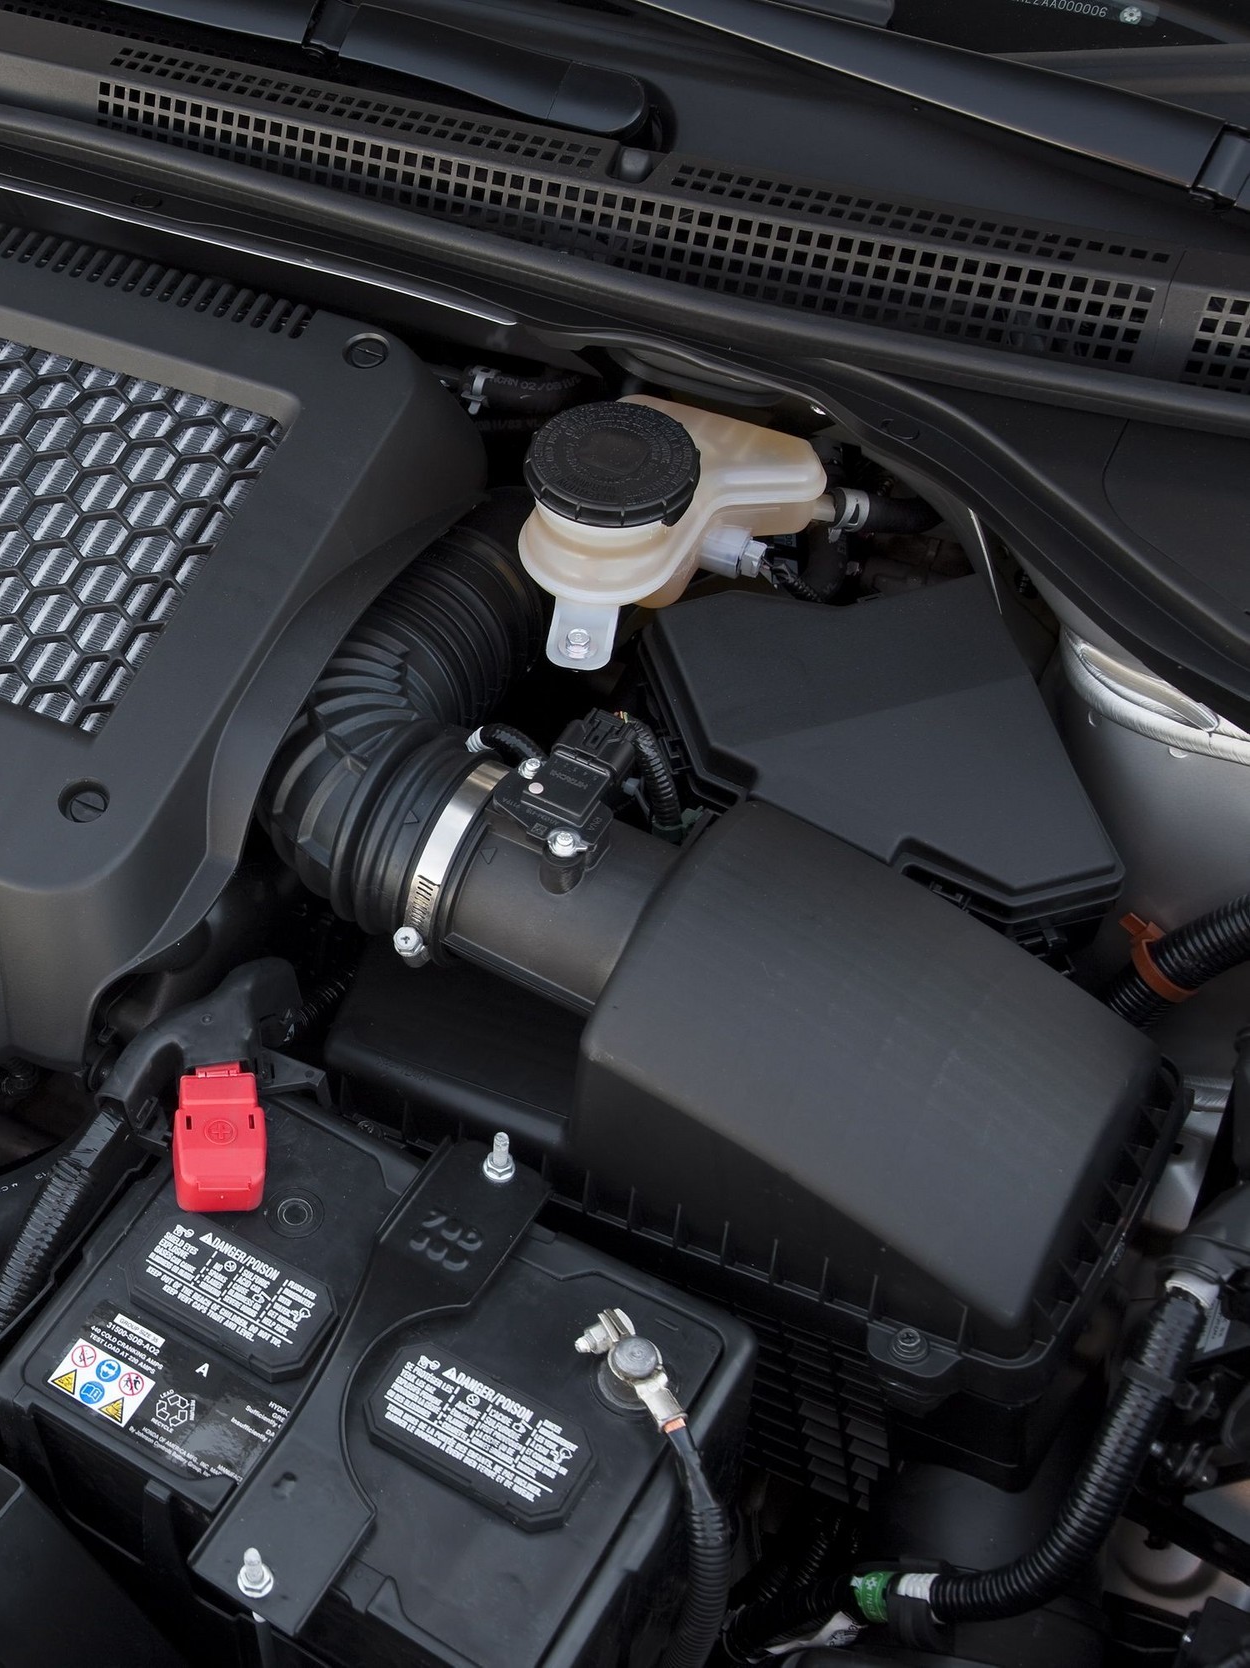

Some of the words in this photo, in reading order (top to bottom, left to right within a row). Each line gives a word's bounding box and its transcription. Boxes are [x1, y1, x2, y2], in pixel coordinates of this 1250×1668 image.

[550, 769, 589, 790] HITACHI
[159, 1239, 190, 1260] EXPLOSIVE
[164, 1232, 185, 1247] SHIELD
[183, 1243, 199, 1255] EYES
[211, 1237, 281, 1281] DANGER/POISON
[213, 1263, 224, 1272] NO
[147, 1266, 162, 1277] KEEP
[209, 1270, 228, 1283] SPARKS
[242, 1270, 271, 1289] SULFURIC
[163, 1285, 179, 1296] KEEP
[178, 1293, 194, 1305] VENT
[192, 1302, 208, 1314] CAPS
[90, 1333, 105, 1344] TEST
[104, 1342, 121, 1354] LOAD
[139, 1362, 156, 1374] AMPS
[102, 1332, 117, 1343] COLD
[117, 1341, 147, 1360] CRANKING
[147, 1358, 164, 1370] AMPS
[196, 1363, 210, 1377] A
[405, 1362, 415, 1372] SE
[442, 1383, 455, 1394] LES
[160, 1390, 174, 1399] LEAD
[456, 1372, 534, 1423] DANGER/POISON
[151, 1418, 174, 1433] RECYCLE
[246, 1406, 278, 1428] Sufficiently
[136, 1431, 154, 1444] Johnson
[231, 1417, 268, 1442] Insufficiently
[143, 1427, 159, 1440] HONDA
[166, 1441, 187, 1456] AMERICA
